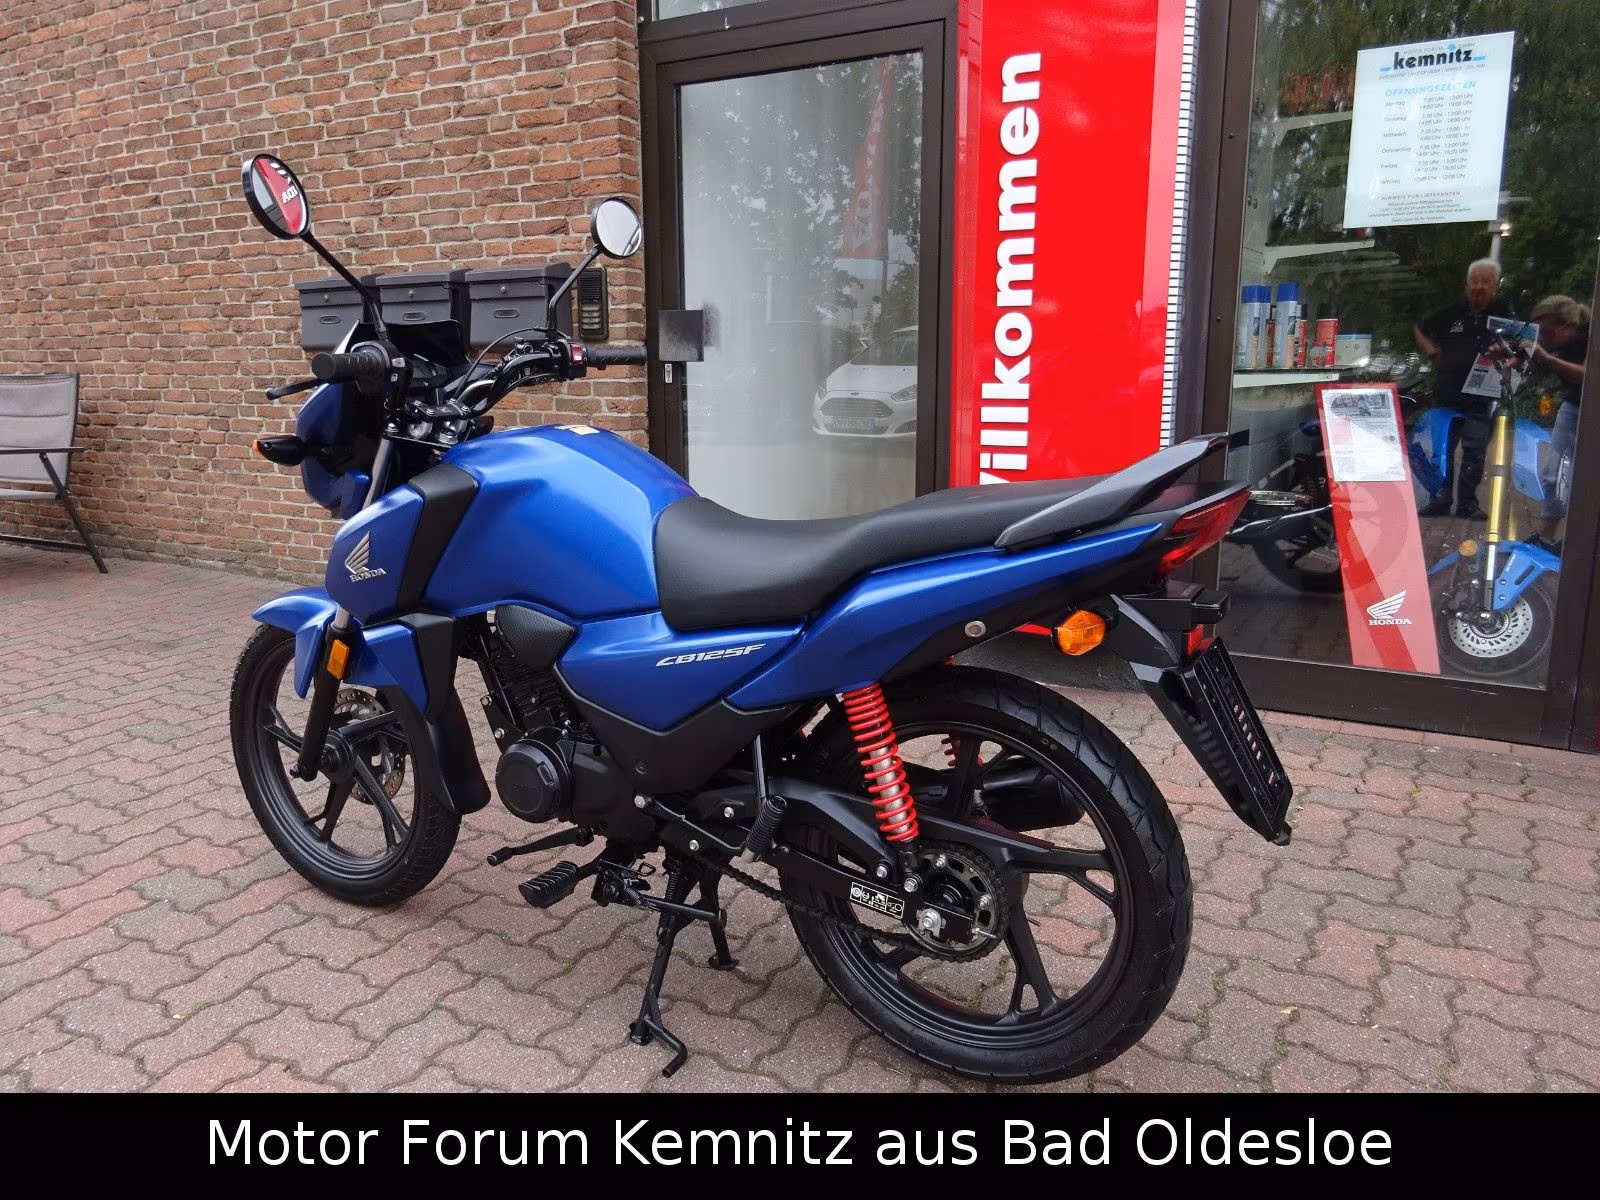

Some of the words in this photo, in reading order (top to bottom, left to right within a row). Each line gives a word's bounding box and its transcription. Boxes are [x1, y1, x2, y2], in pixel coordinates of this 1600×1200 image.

[1393, 44, 1472, 70] kemnitz
[349, 568, 387, 582] HONDA
[656, 643, 766, 666] CB125F
